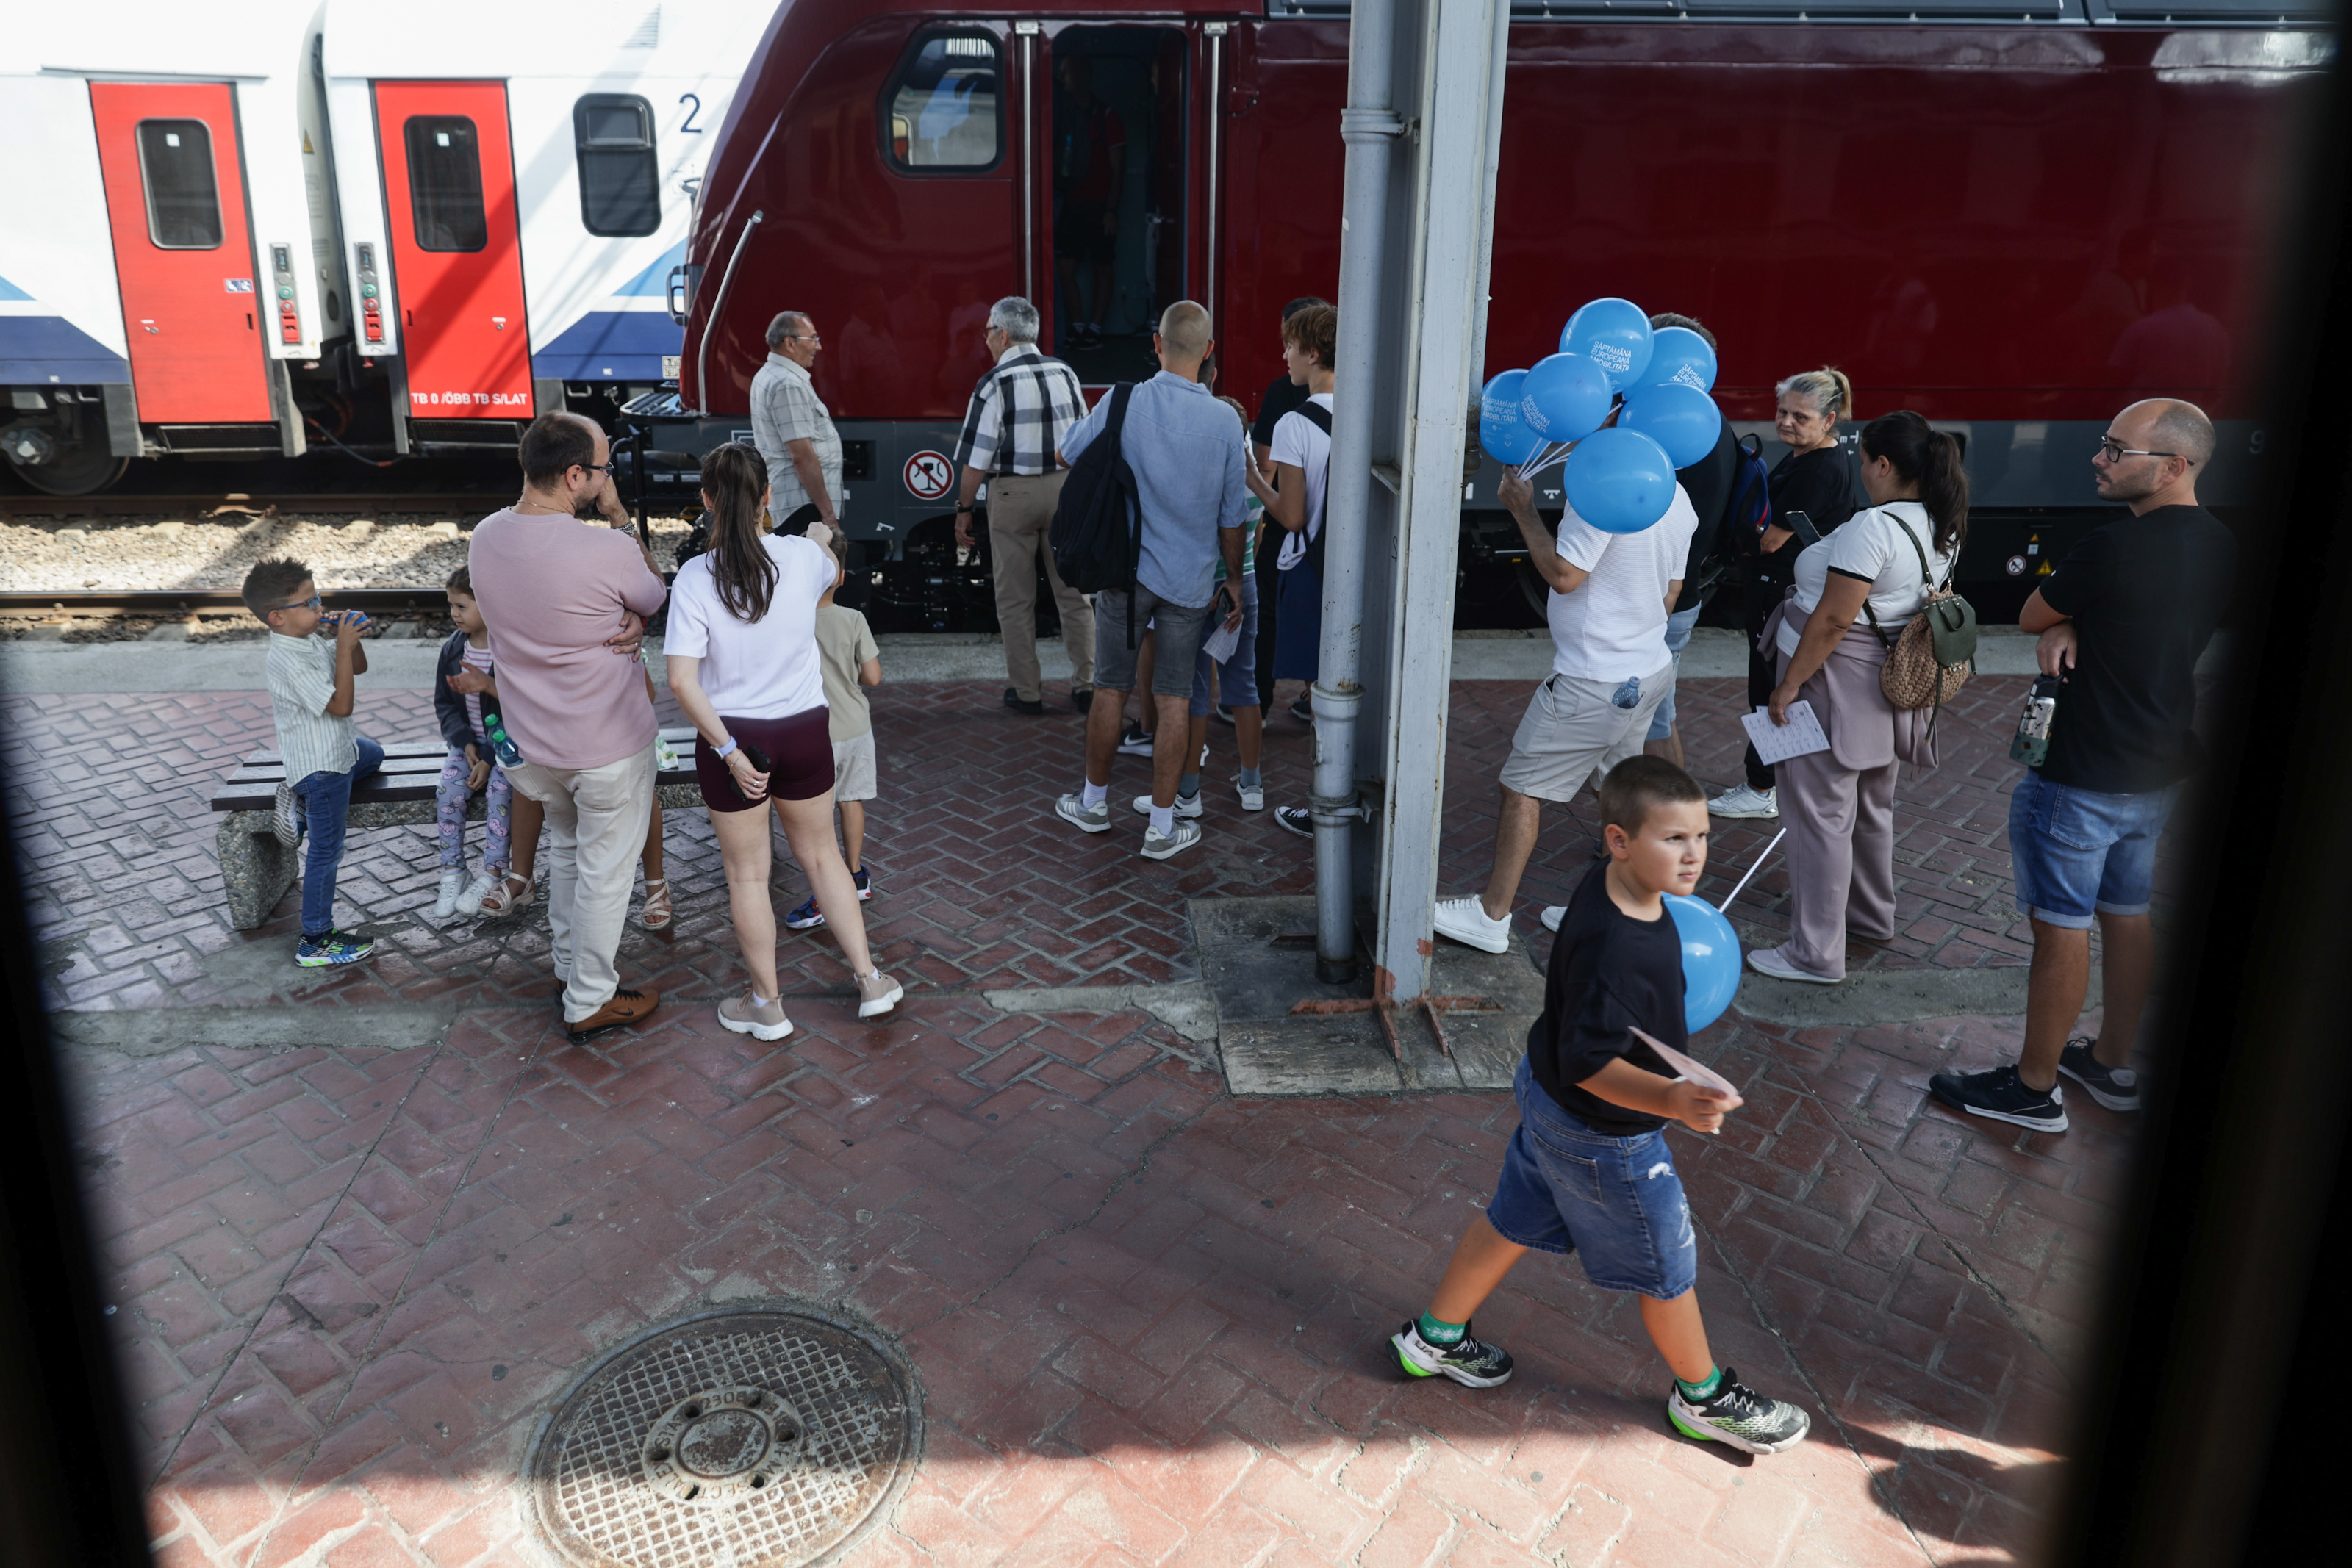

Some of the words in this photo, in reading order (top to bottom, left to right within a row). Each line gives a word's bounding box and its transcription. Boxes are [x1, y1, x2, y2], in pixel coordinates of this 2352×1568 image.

[679, 93, 702, 133] 2
[1591, 348, 1630, 364] EUROPEANĂ
[1593, 340, 1632, 358] SĂPTĂMÂNA
[410, 392, 428, 404] TB
[441, 391, 471, 405] /ÖBB
[473, 393, 490, 404] TB
[492, 393, 528, 405] S/LAT
